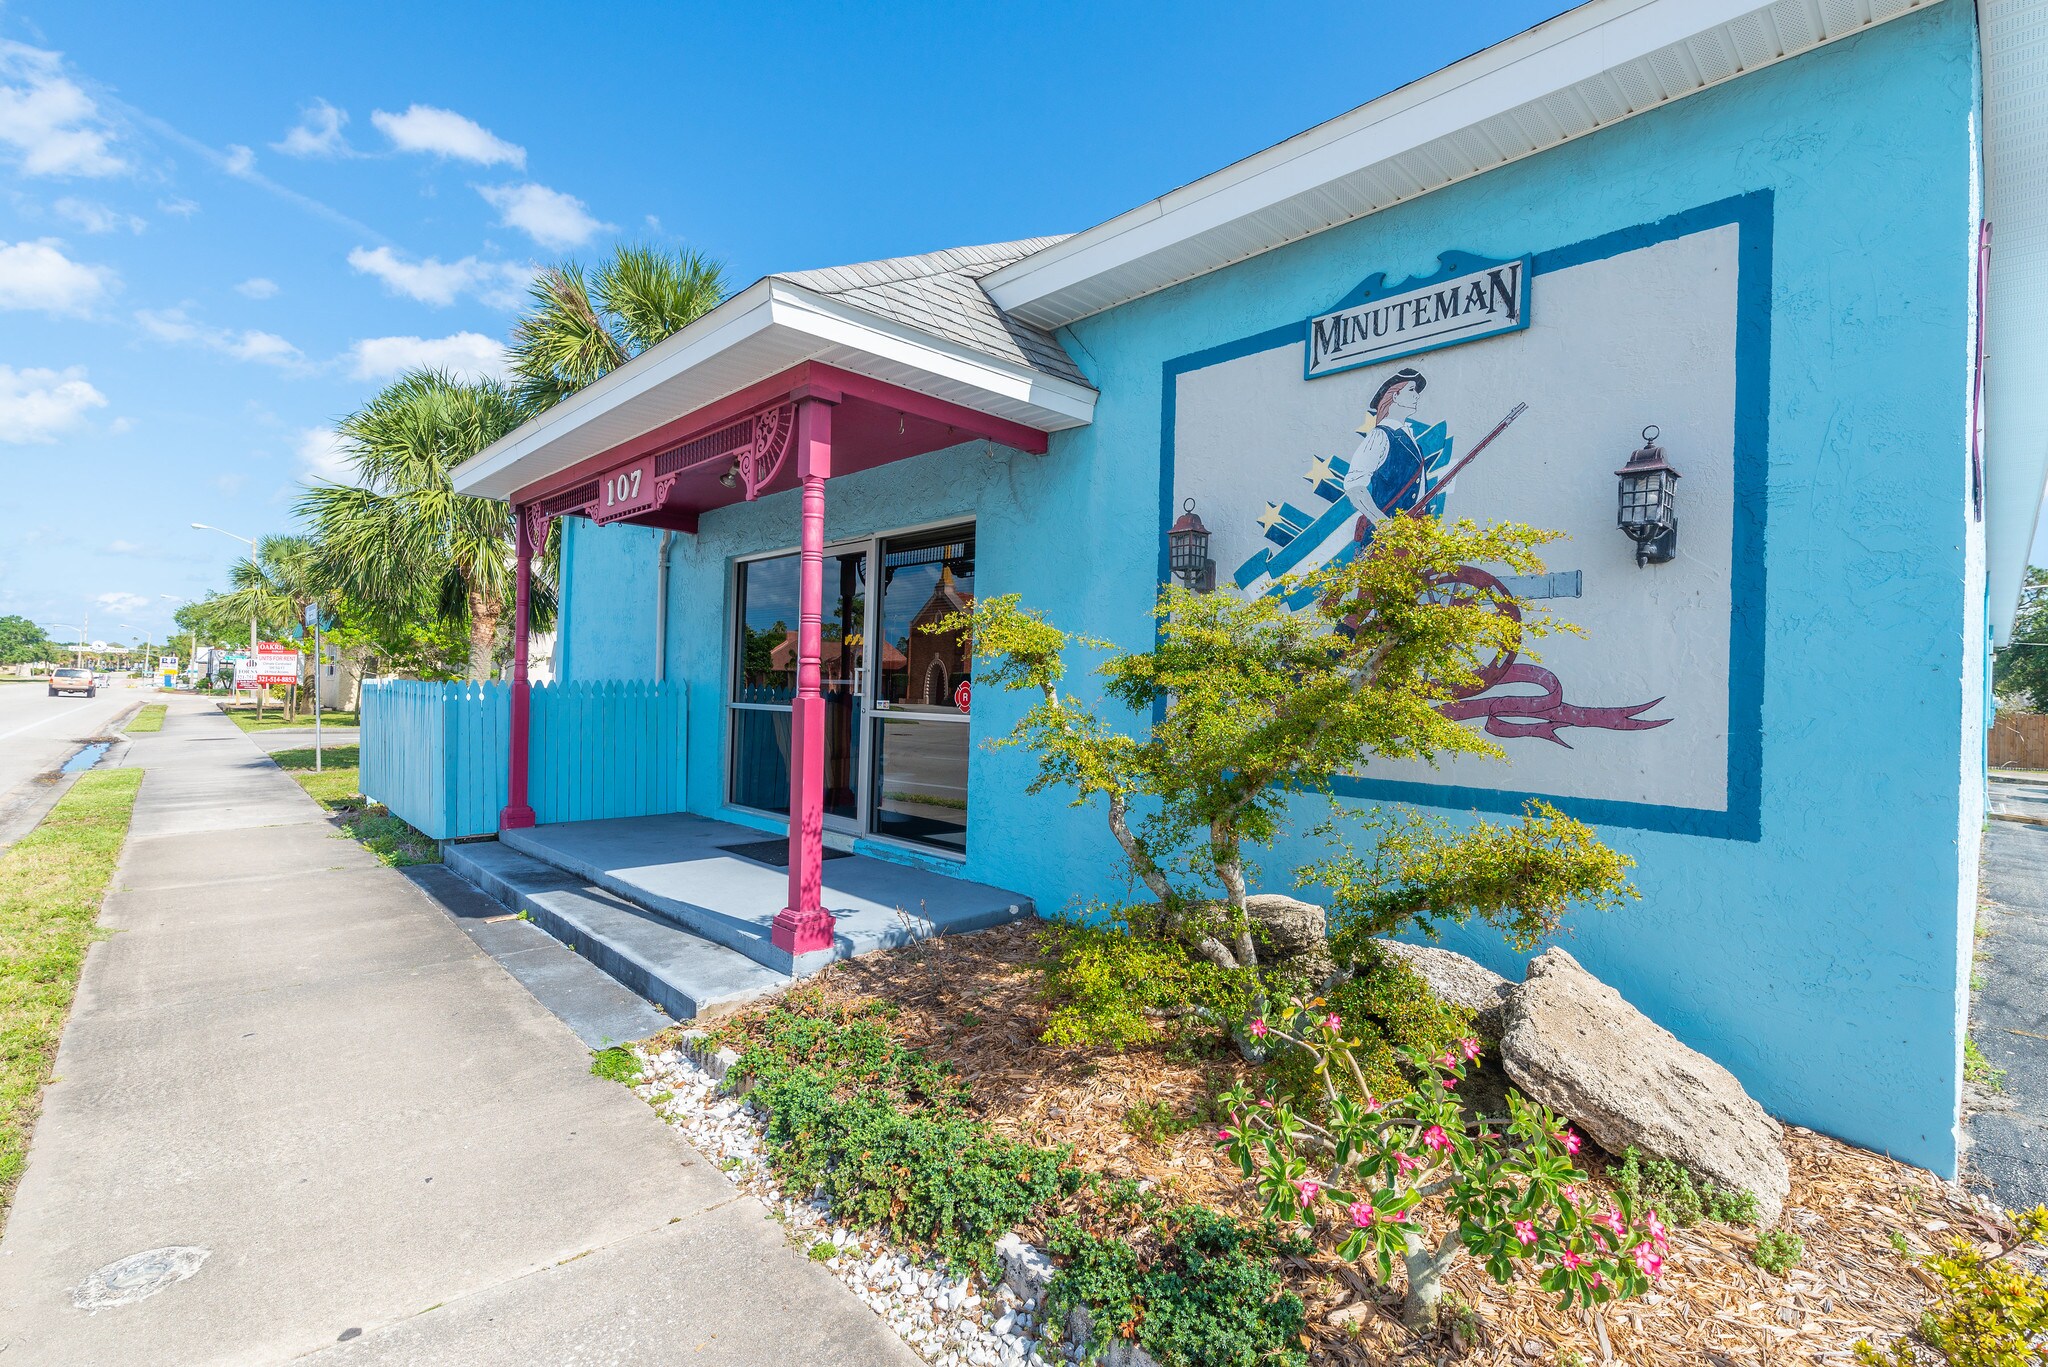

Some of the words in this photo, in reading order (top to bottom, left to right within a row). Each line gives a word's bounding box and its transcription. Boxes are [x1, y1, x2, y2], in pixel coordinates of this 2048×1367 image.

[1310, 263, 1521, 371] MINUTEMAN
[606, 469, 641, 506] 107
[963, 693, 968, 701] R
